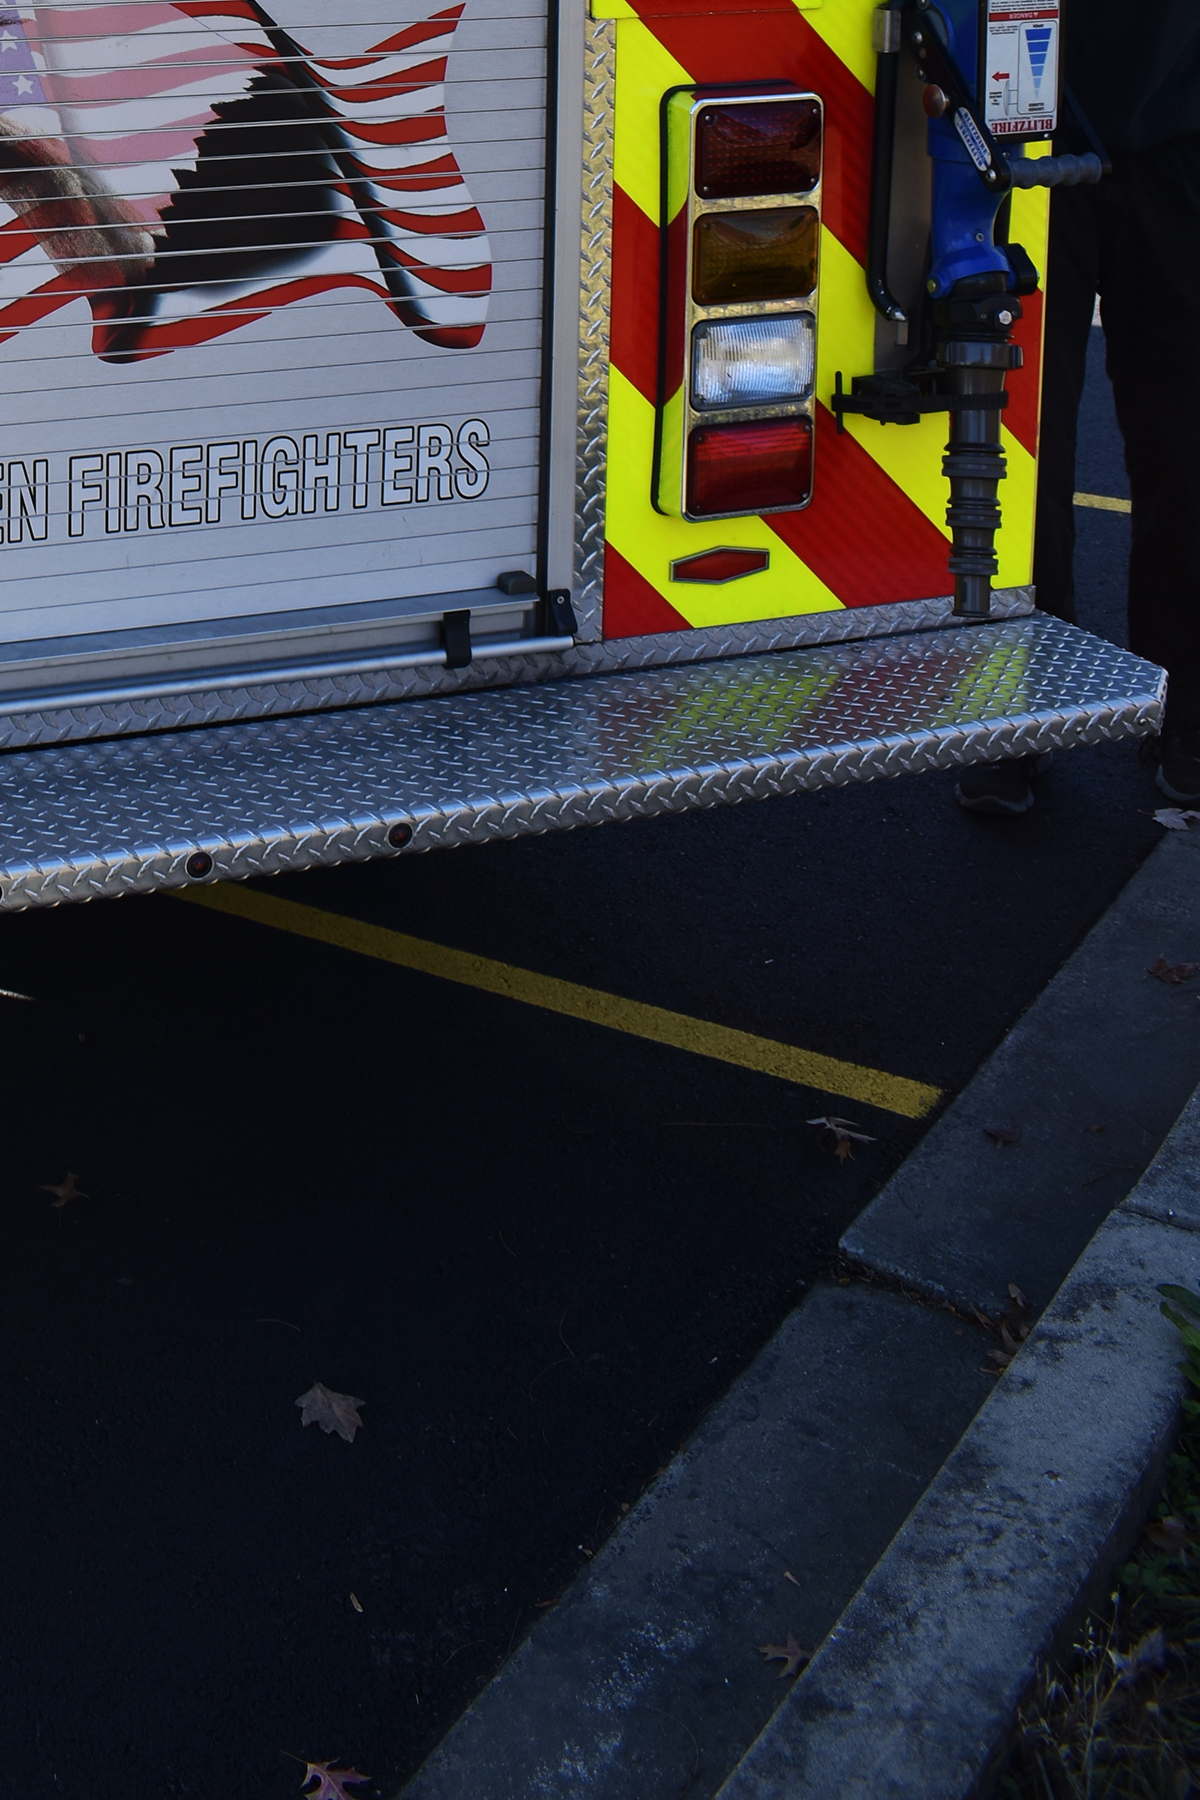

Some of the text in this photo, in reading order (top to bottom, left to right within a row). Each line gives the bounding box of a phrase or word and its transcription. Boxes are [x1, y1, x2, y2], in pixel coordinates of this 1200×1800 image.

[1008, 12, 1033, 20] DANGER
[991, 119, 1054, 134] BLITZFIRE
[68, 418, 491, 538] FIREFIGHTERS
